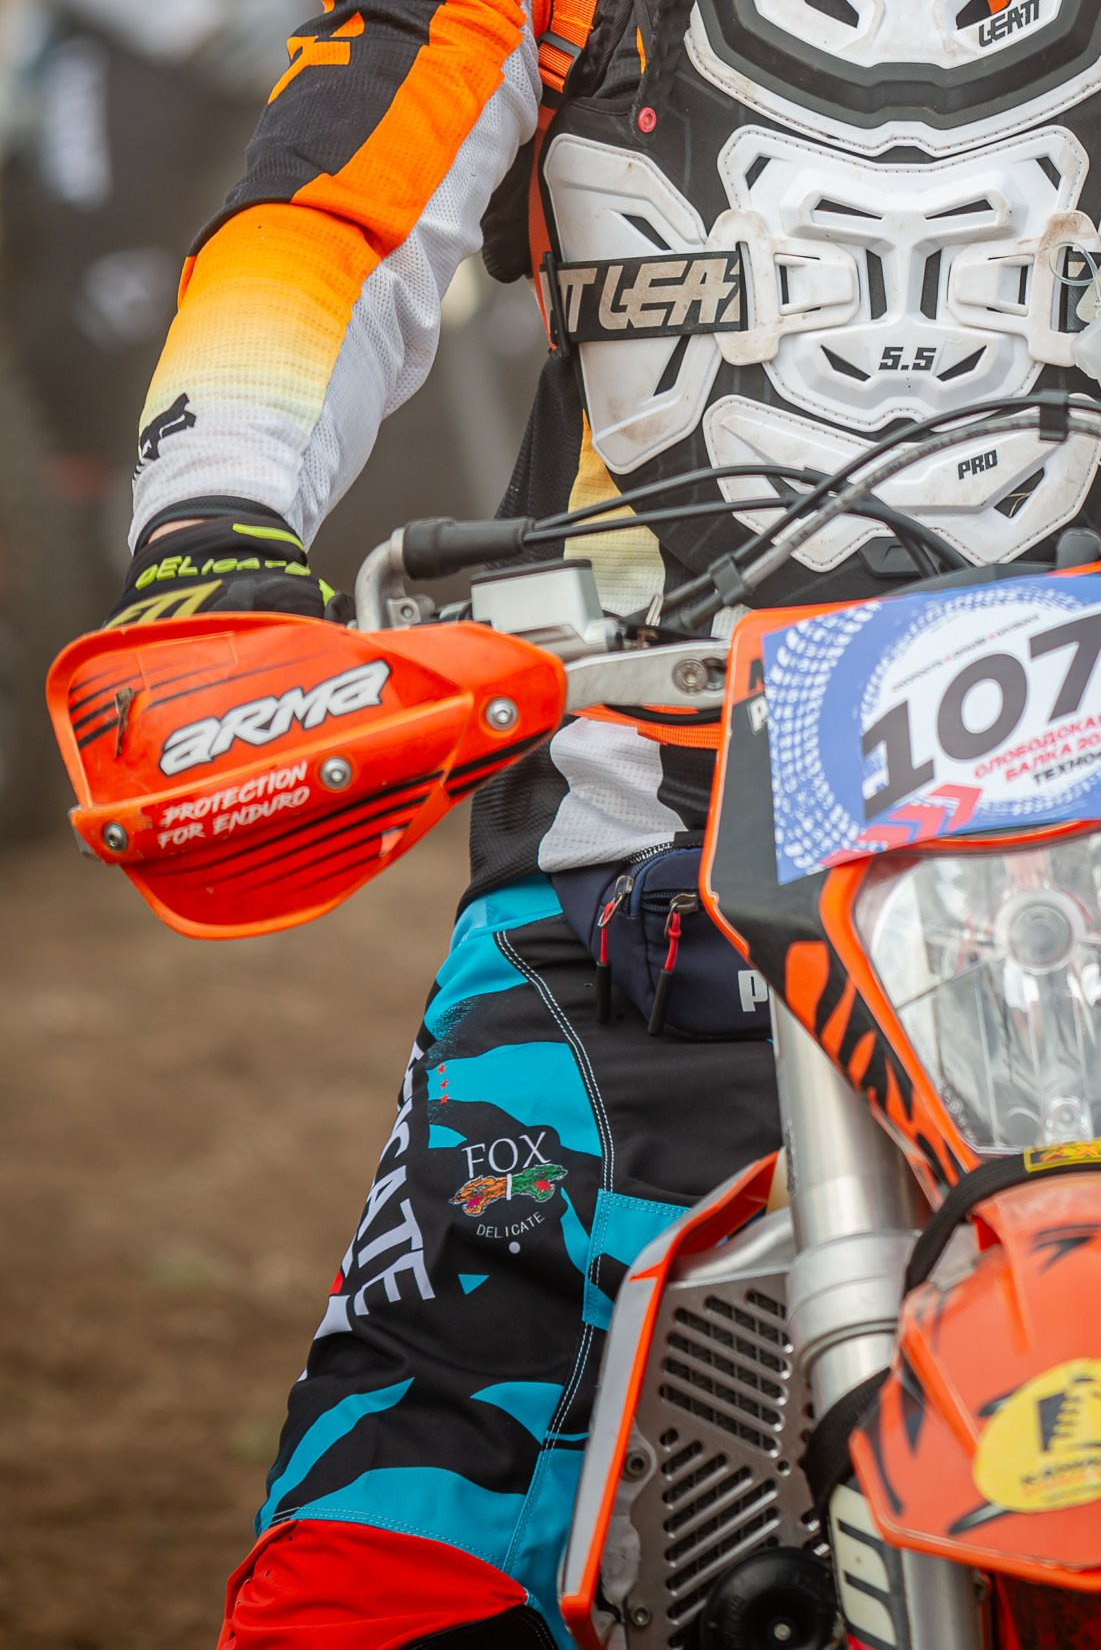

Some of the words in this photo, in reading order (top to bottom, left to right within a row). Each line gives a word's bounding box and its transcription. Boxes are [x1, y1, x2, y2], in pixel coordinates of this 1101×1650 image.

[879, 346, 937, 371] 5.5
[957, 449, 998, 480] PRO
[1004, 742, 1073, 782] БАЛКА
[160, 761, 309, 825] PROTECTION
[157, 822, 207, 849] FOR
[212, 786, 311, 834] ENDURO
[462, 1131, 551, 1178] FOX
[476, 1211, 545, 1238] DELICATE
